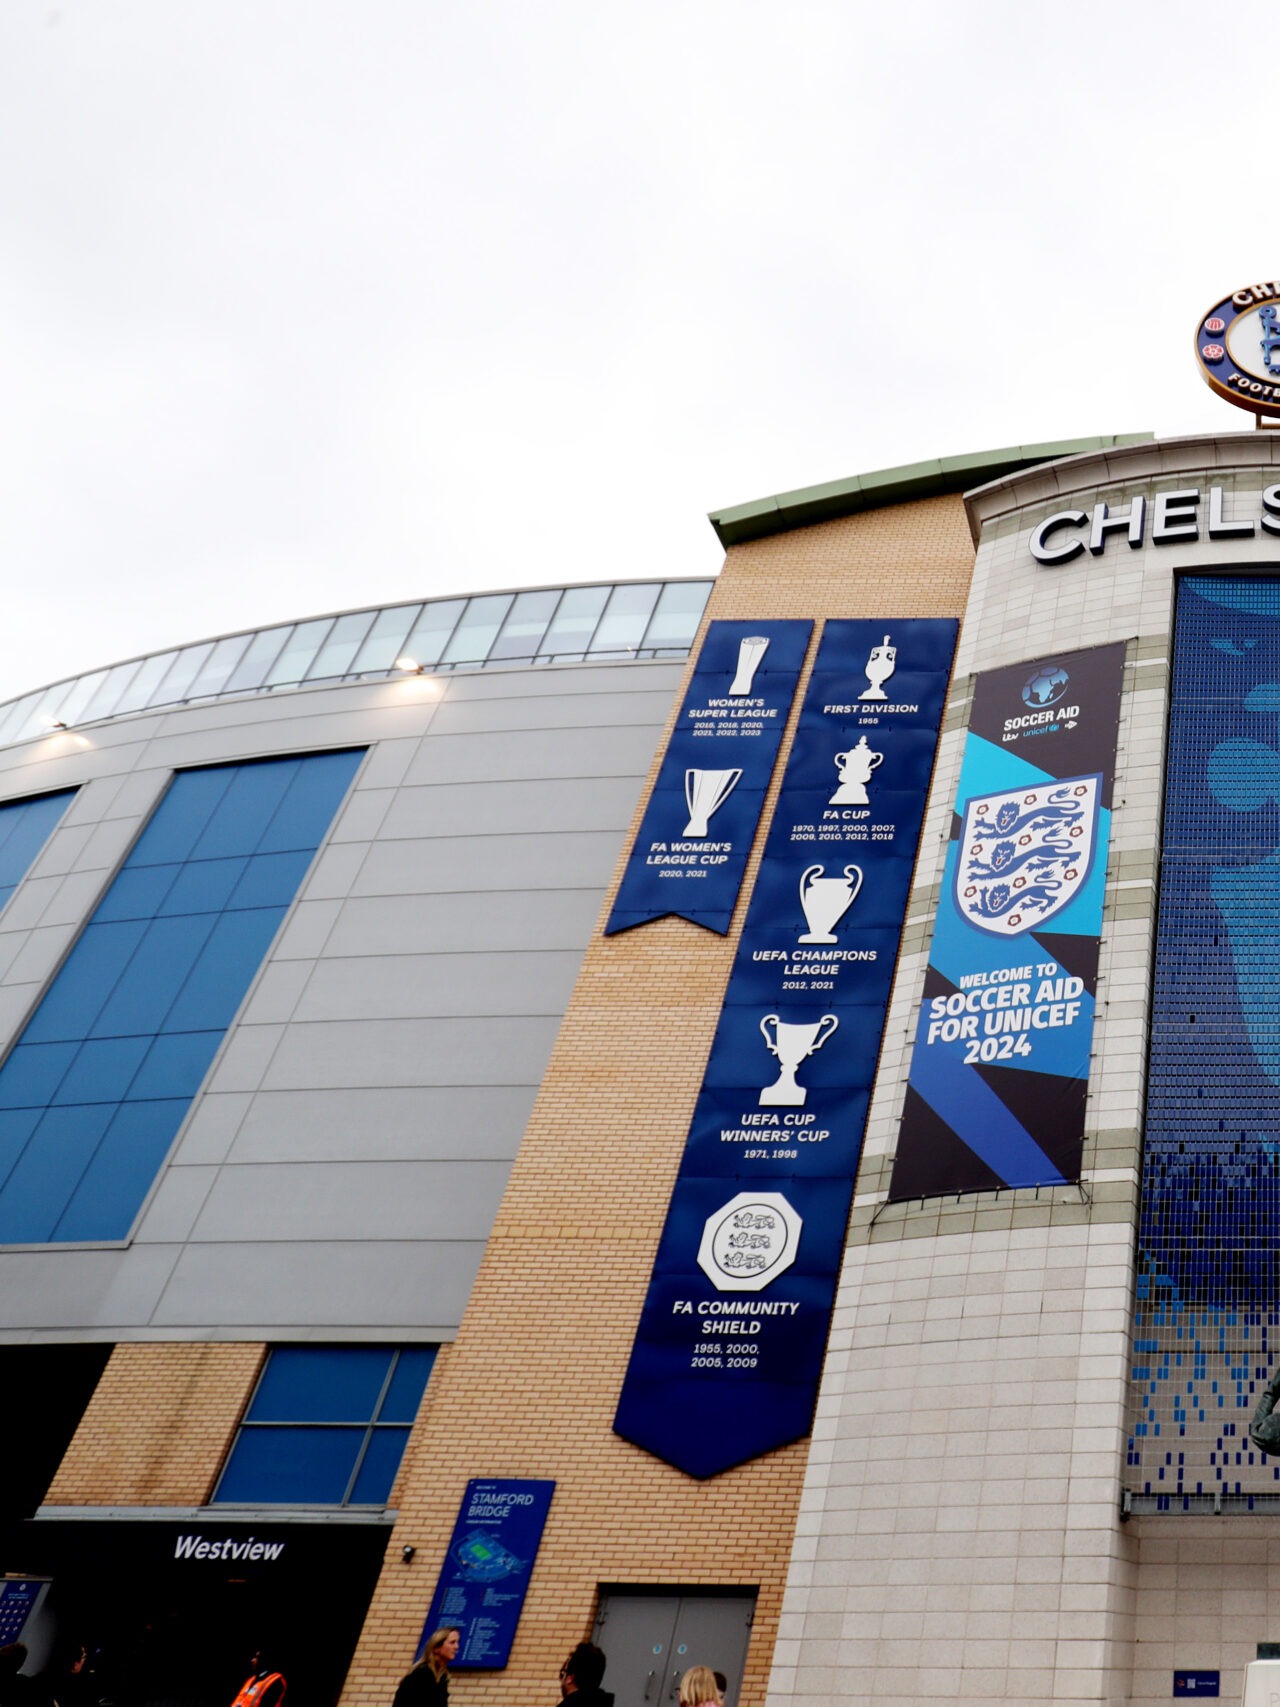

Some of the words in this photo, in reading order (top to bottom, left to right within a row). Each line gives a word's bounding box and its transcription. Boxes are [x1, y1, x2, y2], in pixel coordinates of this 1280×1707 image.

[708, 698, 765, 707] WOMEN'S
[688, 709, 728, 718] SUPER
[730, 709, 778, 718] LEAGUE
[823, 705, 860, 714] FIRST
[861, 704, 919, 713] DIVISION
[1003, 710, 1054, 731] SOCCER
[1056, 705, 1080, 721] AID
[1023, 724, 1049, 737] unicef
[823, 810, 839, 820] FA
[842, 810, 871, 820] CUP
[871, 833, 894, 841] 2018
[650, 842, 667, 852] FA
[671, 842, 732, 852] WOMEN'S
[646, 855, 698, 865] LEAGUE
[700, 855, 729, 865] CUP
[685, 870, 707, 878] 2021
[752, 951, 788, 961] UEFA
[791, 951, 877, 961] CHAMPIONS
[783, 965, 840, 975] LEAGUE
[959, 964, 1033, 989] WELCOME
[1036, 962, 1058, 977] TO
[782, 981, 808, 990] 2012,
[810, 981, 834, 990] 2021
[929, 982, 1031, 1020] SOCCER
[1034, 976, 1084, 1003] AID
[927, 1015, 979, 1045] FOR
[983, 1001, 1081, 1036] UNICEF
[963, 1033, 1032, 1064] 2024
[741, 1114, 780, 1126] UEFA
[783, 1114, 816, 1126] CUP
[797, 1130, 830, 1142] CUP
[743, 1149, 770, 1159] 1971,
[772, 1149, 798, 1159] 1998
[672, 1301, 693, 1314] FA
[697, 1301, 800, 1316] COMMUNITY
[702, 1320, 761, 1334] SHIELD
[693, 1343, 723, 1354] 1955,
[726, 1344, 760, 1355] 2000,
[690, 1357, 724, 1368] 2005,
[726, 1357, 758, 1368] 2009
[471, 1493, 534, 1505] STAMFORD
[468, 1505, 511, 1517] BRIDGE
[174, 1535, 285, 1561] Westview
